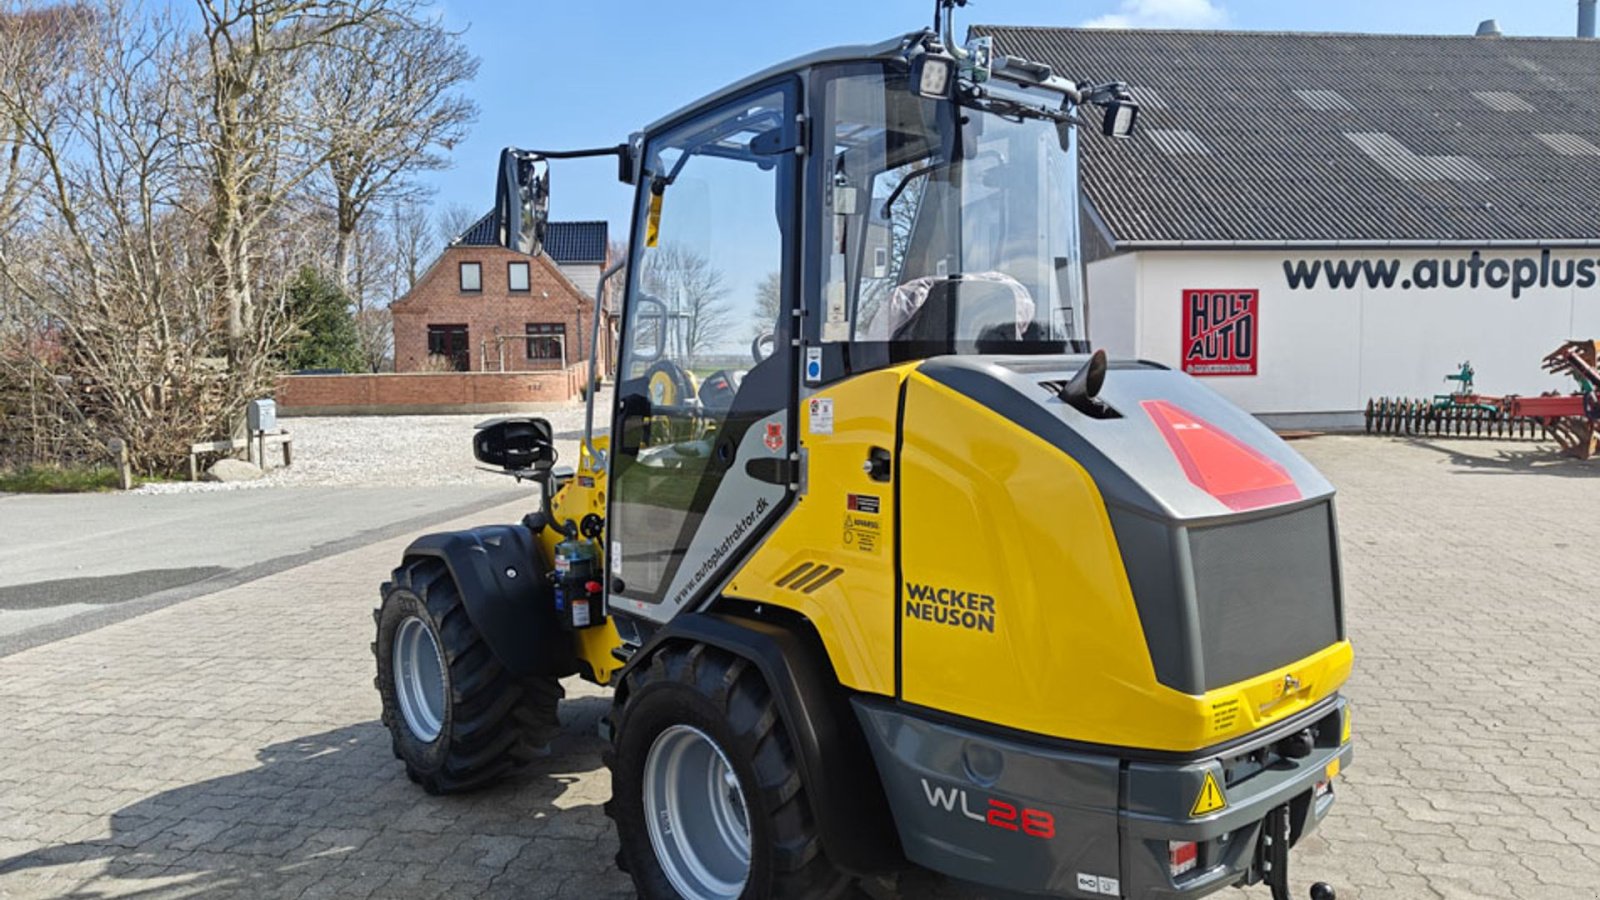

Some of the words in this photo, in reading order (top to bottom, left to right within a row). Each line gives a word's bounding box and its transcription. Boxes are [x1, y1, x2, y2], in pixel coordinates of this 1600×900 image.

[1283, 249, 1600, 299] www.autoplus
[1186, 313, 1252, 360] AUTO
[1190, 293, 1254, 339] HOLT
[673, 497, 769, 605] www.autoplustraktor.dk
[905, 602, 995, 633] NEUSON
[906, 582, 996, 614] WACKER
[920, 778, 1056, 840] WL28
